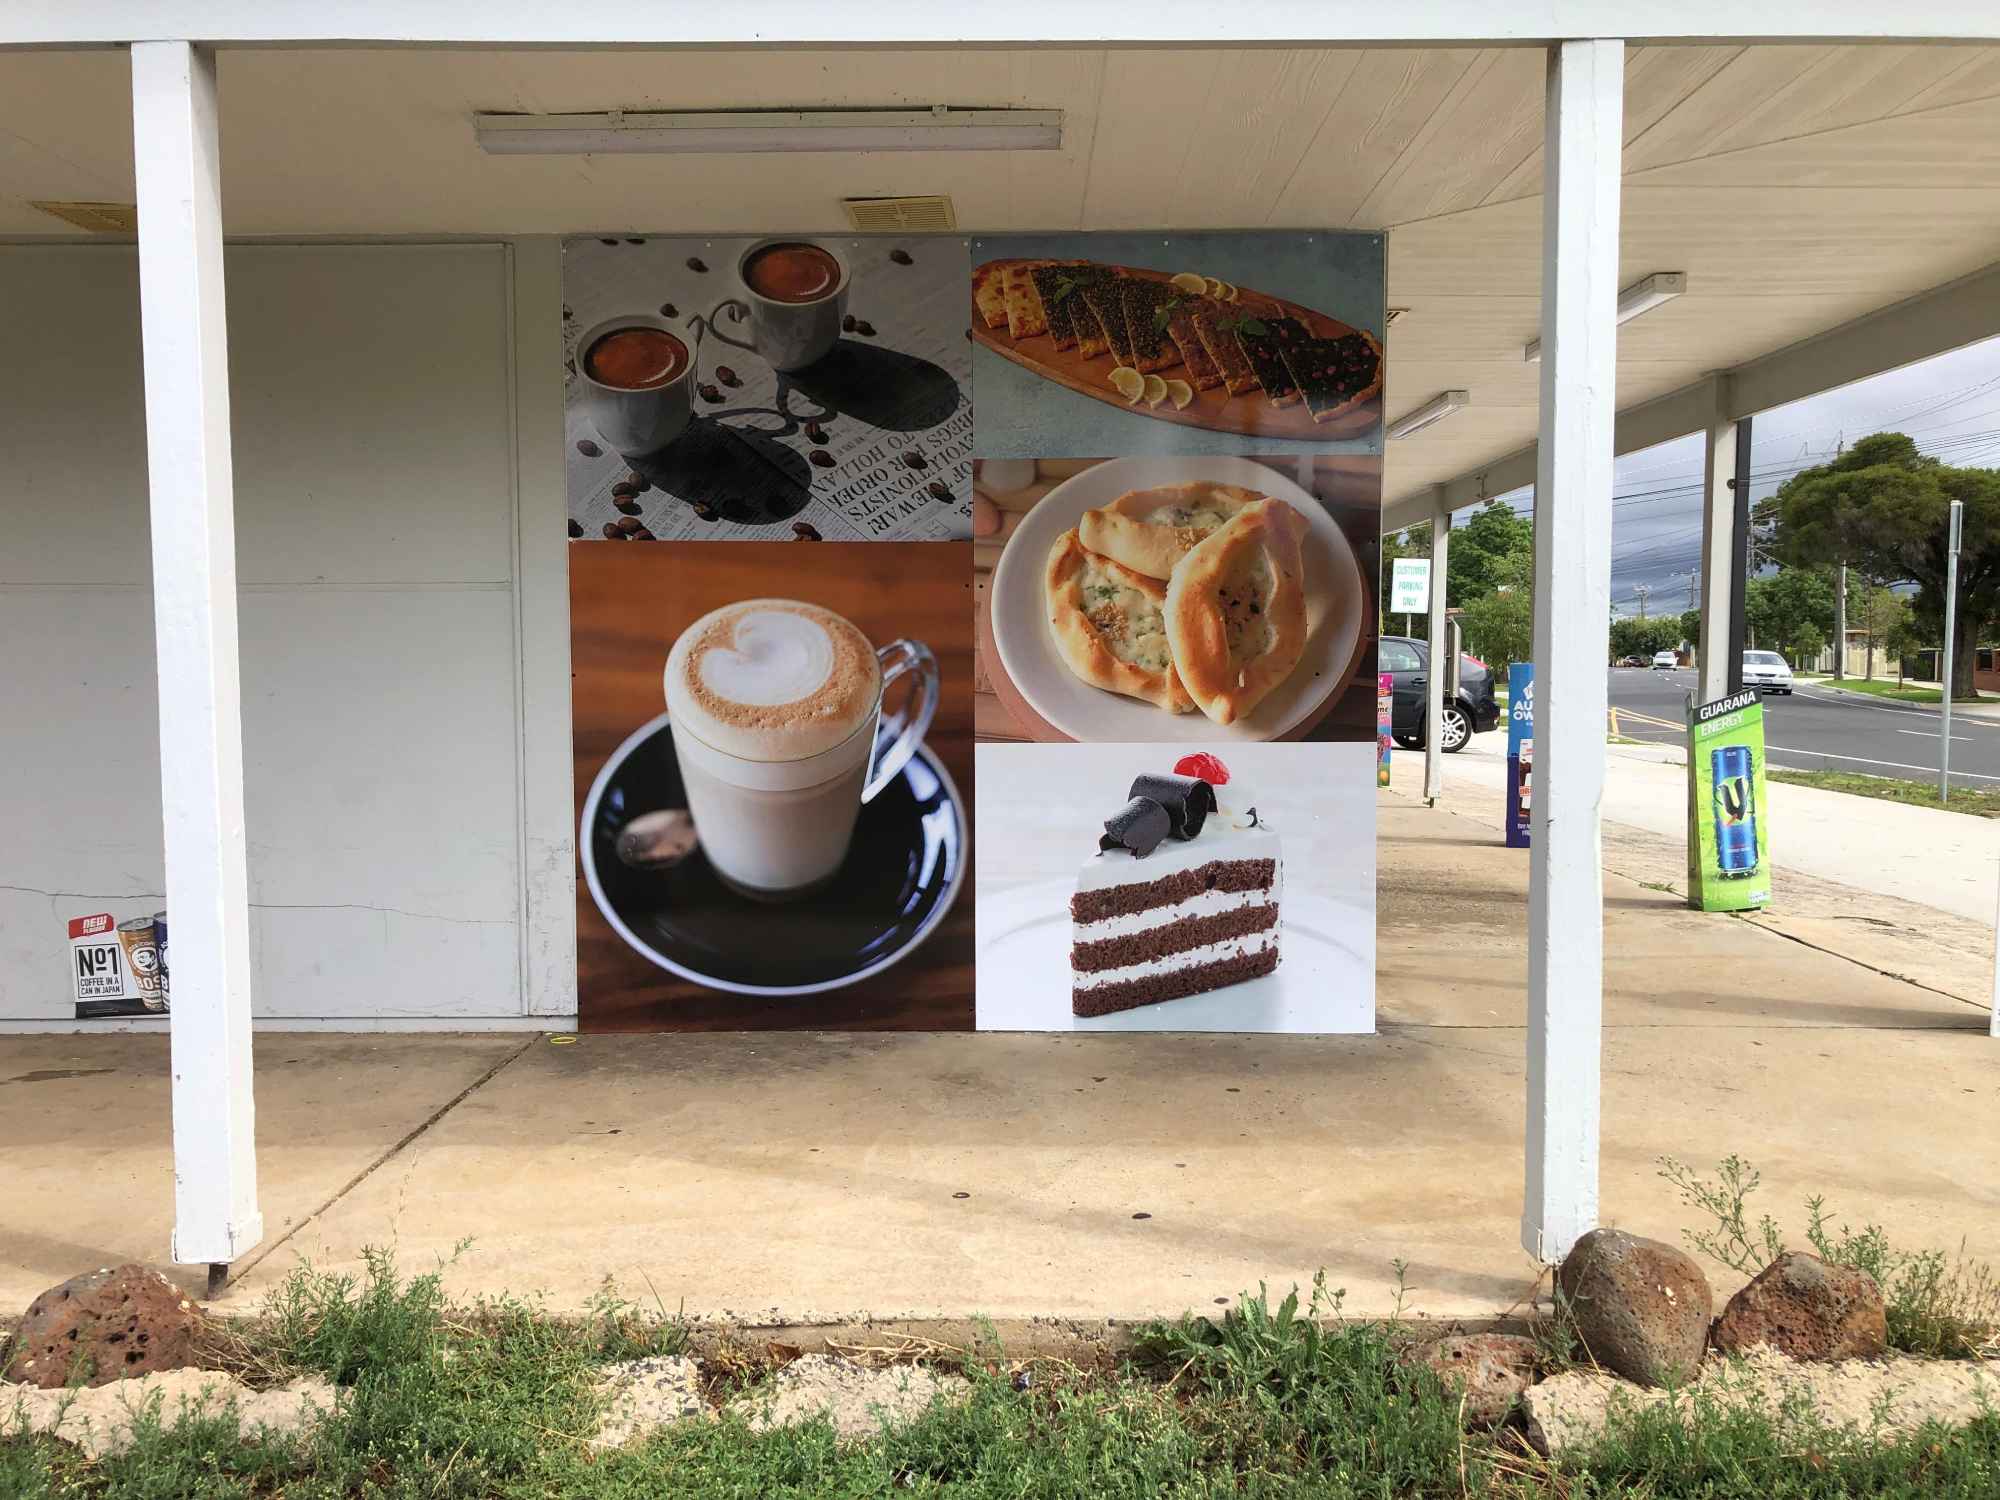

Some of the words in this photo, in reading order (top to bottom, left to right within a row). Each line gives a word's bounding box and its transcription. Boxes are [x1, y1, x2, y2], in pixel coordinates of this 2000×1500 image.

[888, 443, 929, 472] FR
[1396, 565, 1427, 576] CUSTOMER
[1398, 581, 1424, 592] PARKING
[1402, 596, 1418, 608] ONLY
[1700, 690, 1756, 720] GUARANA
[1701, 710, 1745, 736] ENERGY
[80, 977, 105, 987] COFFEE
[105, 976, 113, 986] IN
[114, 976, 120, 985] A
[80, 986, 93, 996] CAN
[95, 986, 101, 995] IN
[101, 985, 120, 995] JAPAN
